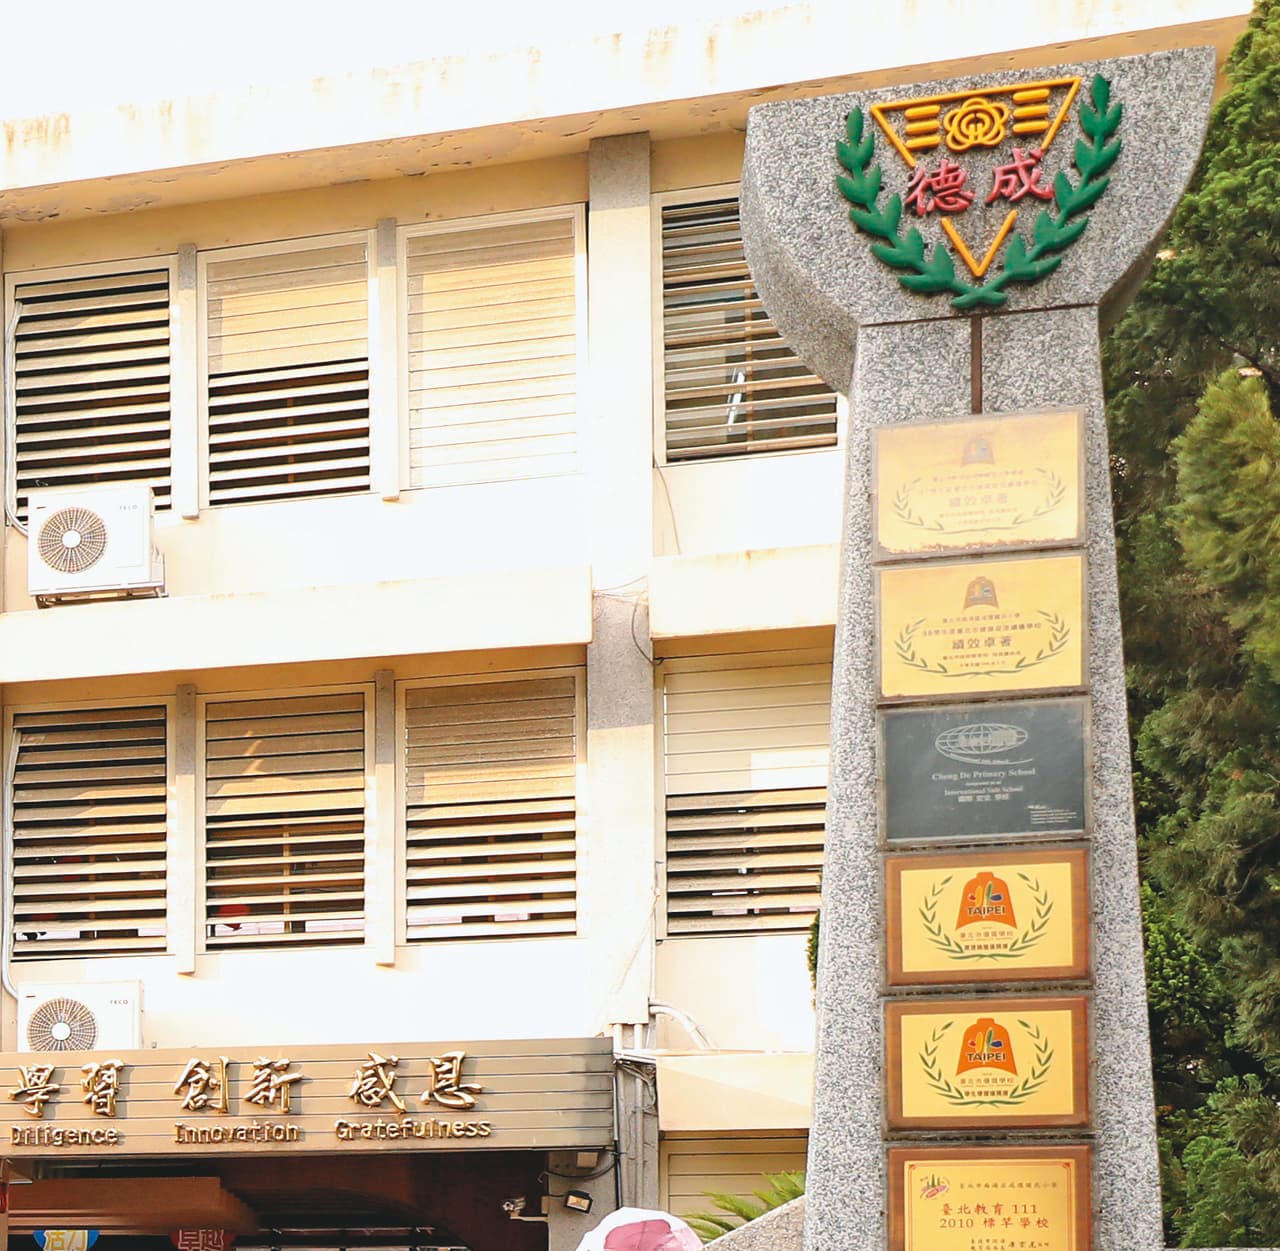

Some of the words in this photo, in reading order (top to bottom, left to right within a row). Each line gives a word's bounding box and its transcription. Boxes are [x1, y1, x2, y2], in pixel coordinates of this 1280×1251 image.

[967, 905, 1006, 916] TAIPEI
[967, 1052, 1006, 1063] TAIPEI
[8, 1058, 124, 1117] 學習
[174, 1055, 304, 1113] 創新
[349, 1050, 482, 1114] 感恩
[9, 1124, 118, 1147] Diligence
[174, 1120, 300, 1143] Innovation
[334, 1117, 491, 1140] Gratefulness
[941, 1202, 1004, 1216] 臺北教育
[1011, 1203, 1039, 1214] 111
[939, 1218, 974, 1229] 2010
